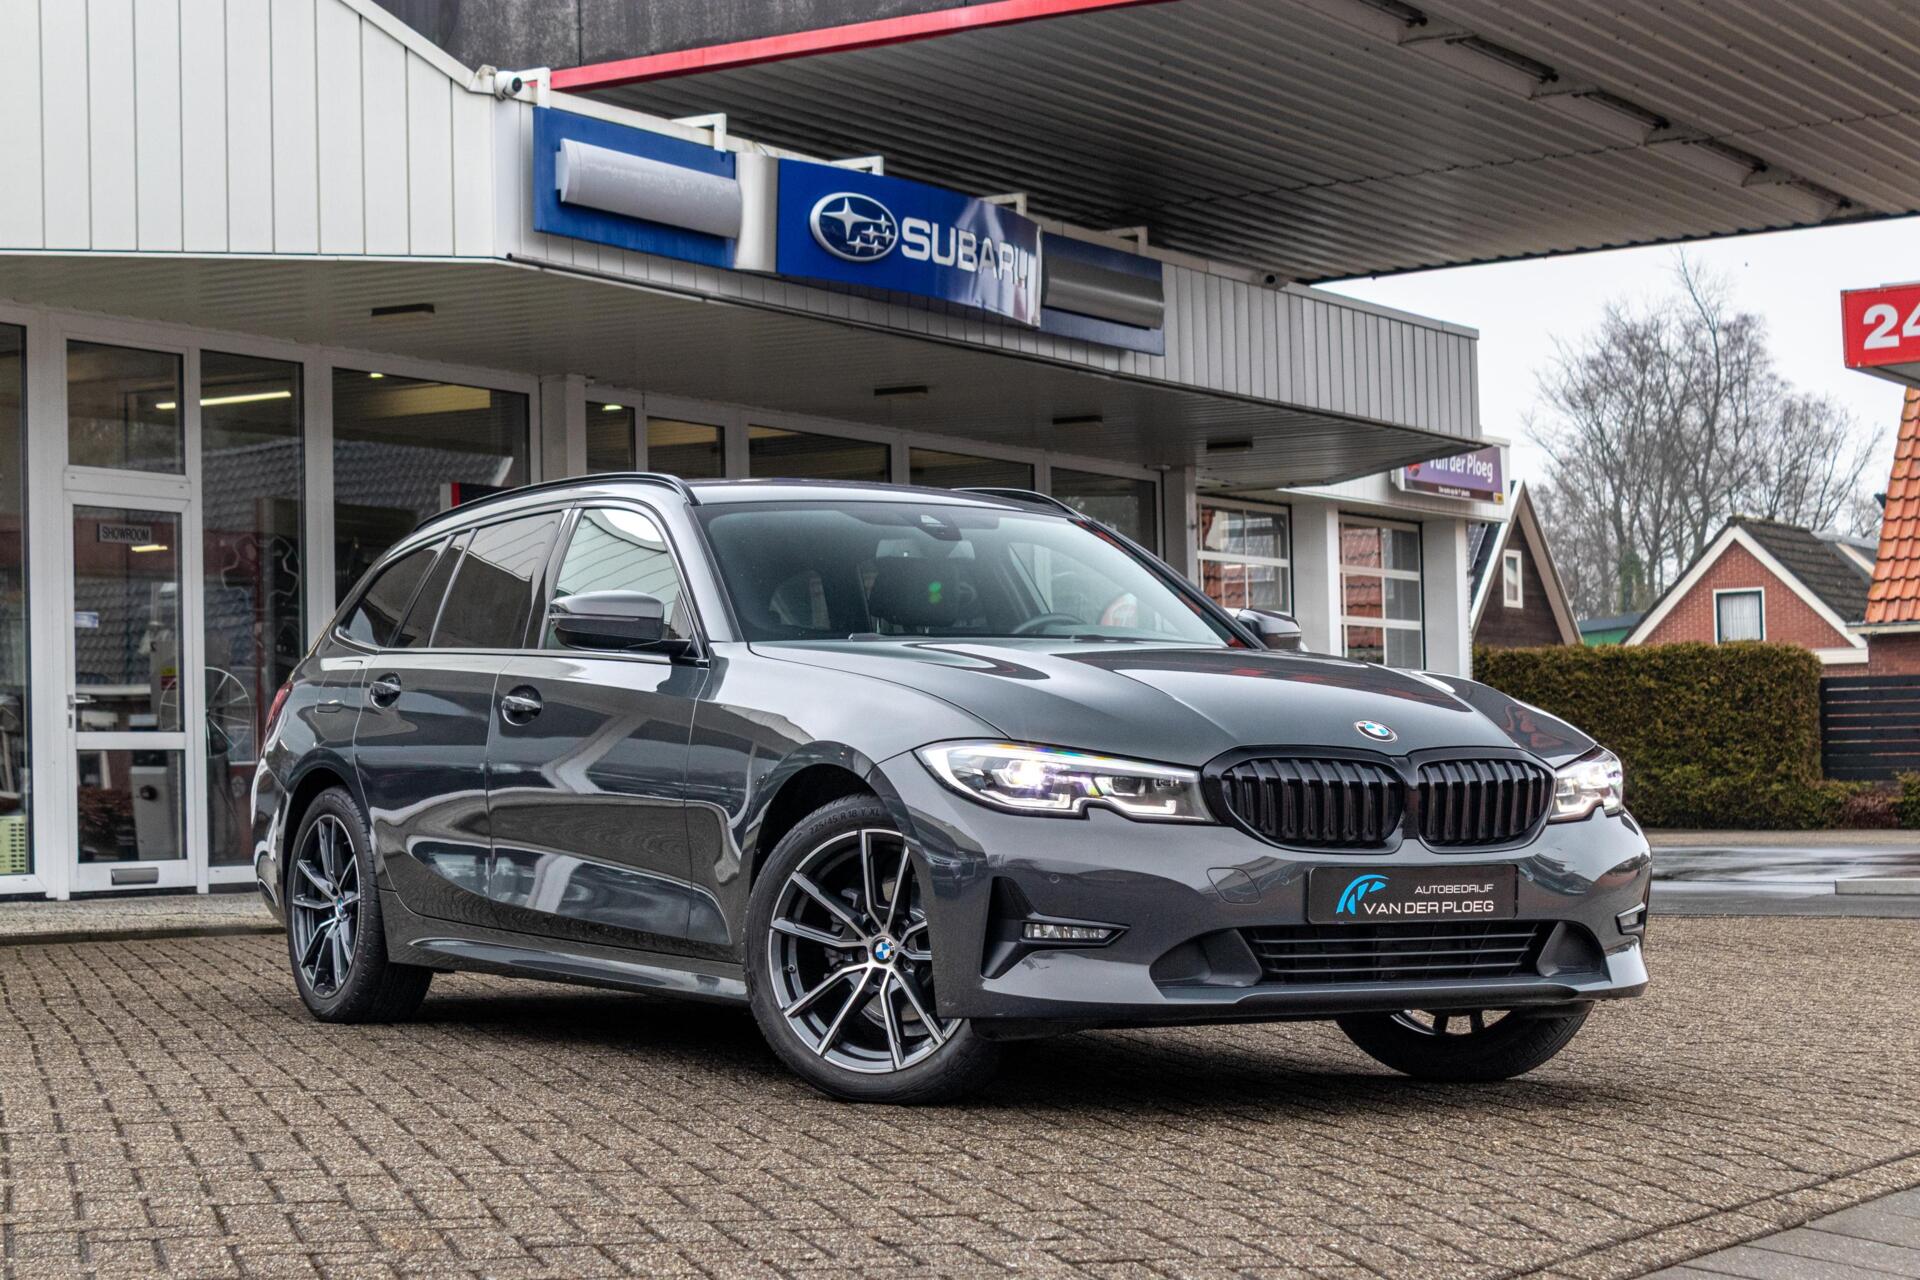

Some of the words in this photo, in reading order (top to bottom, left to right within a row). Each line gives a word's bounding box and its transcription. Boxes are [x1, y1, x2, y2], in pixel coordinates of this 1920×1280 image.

[1466, 454, 1493, 483] Ploeg
[102, 526, 149, 541] SHOWROOM
[1414, 884, 1495, 895] AUTOBEDRIJF
[1363, 902, 1401, 915] VAN
[1404, 901, 1440, 915] DER
[1442, 900, 1494, 914] PLOEG
